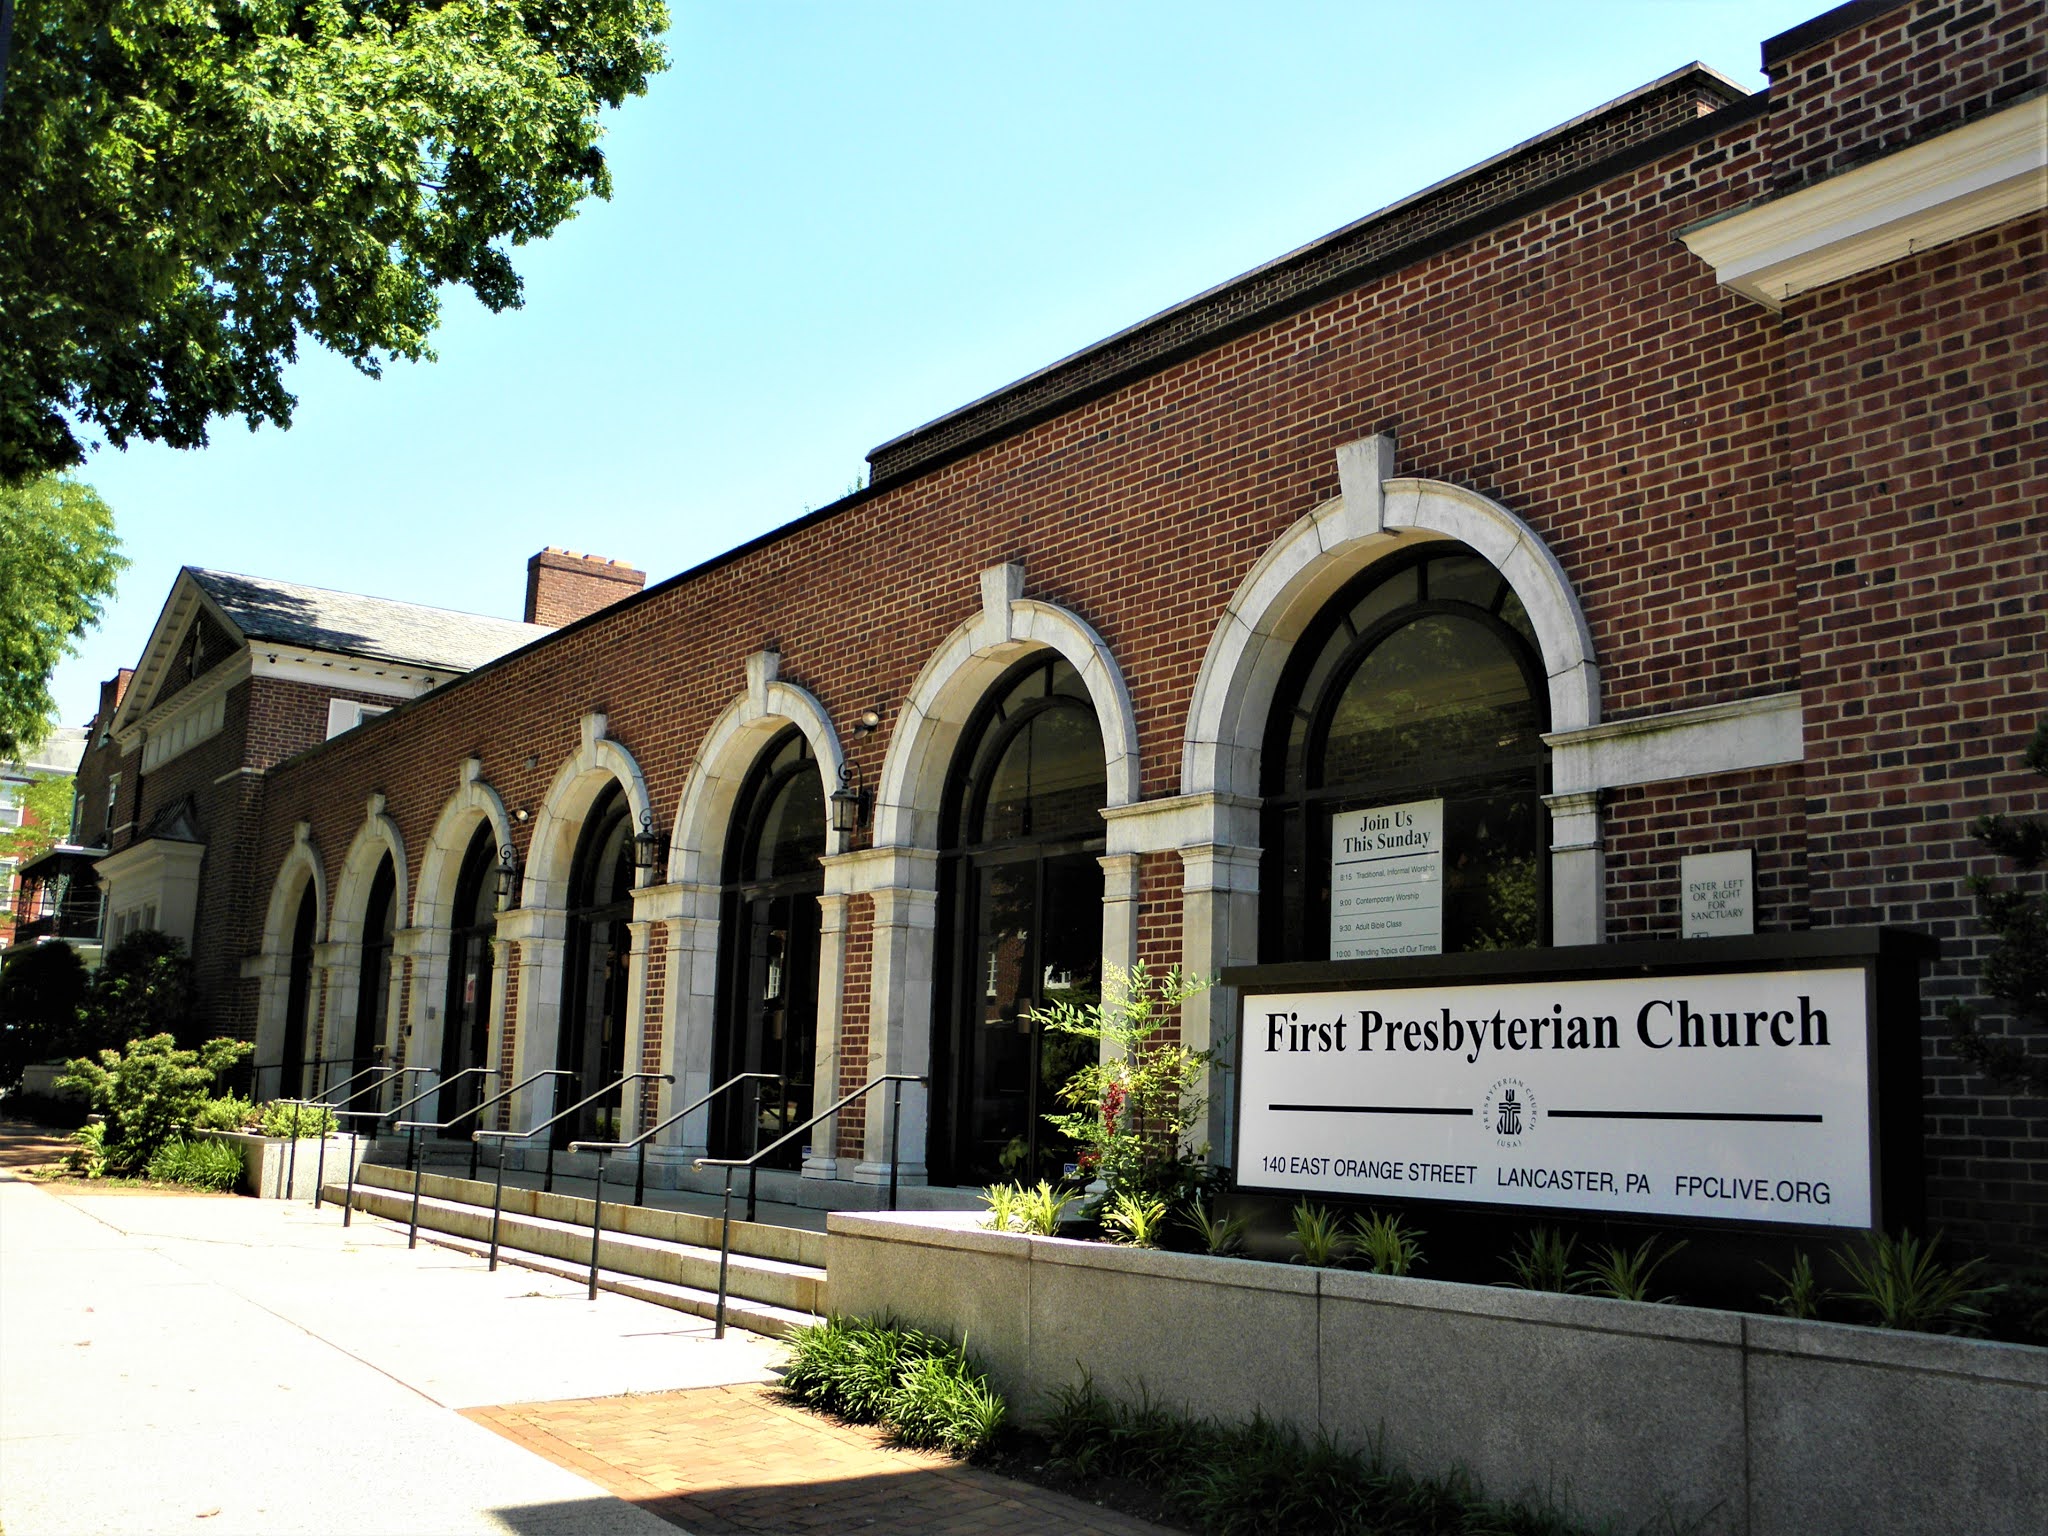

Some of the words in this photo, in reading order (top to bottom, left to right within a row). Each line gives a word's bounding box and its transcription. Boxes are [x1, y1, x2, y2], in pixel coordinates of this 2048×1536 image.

[1360, 815, 1390, 833] Join
[1395, 810, 1413, 828] Us
[1343, 836, 1373, 854] This
[1377, 829, 1431, 850] Sunday
[1340, 873, 1352, 881] 8:15
[1356, 870, 1385, 879] Traditional,
[1387, 867, 1410, 875] Informal
[1411, 864, 1435, 873] Worship
[1690, 882, 1716, 892] ENTER
[1724, 880, 1744, 889] LEFT
[1356, 895, 1394, 906] Contemporary
[1396, 892, 1420, 900] Worship
[1692, 892, 1706, 901] OR
[1713, 889, 1741, 900] RIGHT
[1708, 900, 1726, 910] FOR
[1690, 908, 1744, 920] SANCTUARY
[1356, 948, 1379, 956] Trending
[1380, 947, 1398, 955] Topics
[1265, 1012, 1347, 1052] First
[1358, 1004, 1620, 1064] Presbyterian
[1636, 996, 1831, 1048] Church
[1483, 1078, 1523, 1130] PRESBYTERIAN
[1526, 1088, 1537, 1131] CHURCH
[1496, 1139, 1522, 1148] (USA)
[1263, 1156, 1286, 1173] 140
[1290, 1157, 1330, 1176] EAST
[1334, 1159, 1403, 1180] ORANGE
[1408, 1163, 1477, 1184] STREET
[1498, 1168, 1618, 1195] LANCASTER,
[1626, 1174, 1650, 1194] PA
[1675, 1176, 1830, 1204] FPCLIVE.ORG
